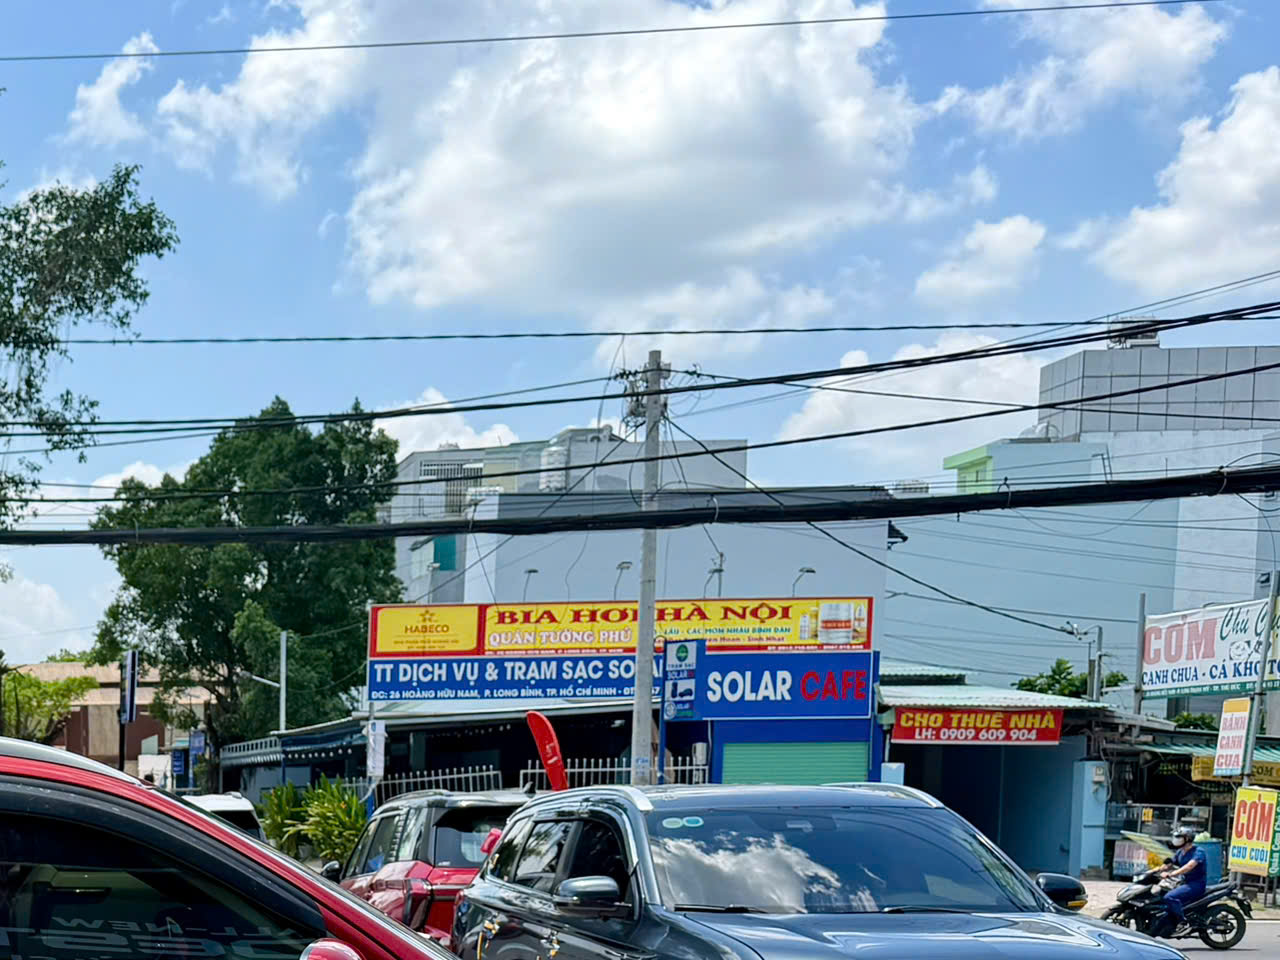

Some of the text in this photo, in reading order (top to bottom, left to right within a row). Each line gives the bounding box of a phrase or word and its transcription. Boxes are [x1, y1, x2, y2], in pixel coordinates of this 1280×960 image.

[496, 609, 559, 625] BIA
[656, 603, 712, 622] HÀ
[720, 602, 793, 624] NỘI
[404, 624, 450, 634] HABECO
[1143, 614, 1219, 665] CƠM
[374, 663, 393, 683] TT
[452, 661, 479, 686] VỤ
[485, 662, 499, 681] &
[504, 660, 557, 685] TRẠM
[561, 659, 604, 684] SẠC
[1142, 669, 1169, 686] CANH
[1171, 666, 1199, 683] CHUA
[1209, 658, 1228, 680] CÁ
[493, 688, 519, 697] LONG
[592, 686, 617, 695] MINH
[707, 670, 868, 703] SOLAR CAFE
[900, 711, 1056, 729] CHO THUÊ NHÀ
[915, 728, 1038, 740] LH: 0909 609 904
[1216, 753, 1241, 768] CUA
[1235, 792, 1275, 842] CƠM
